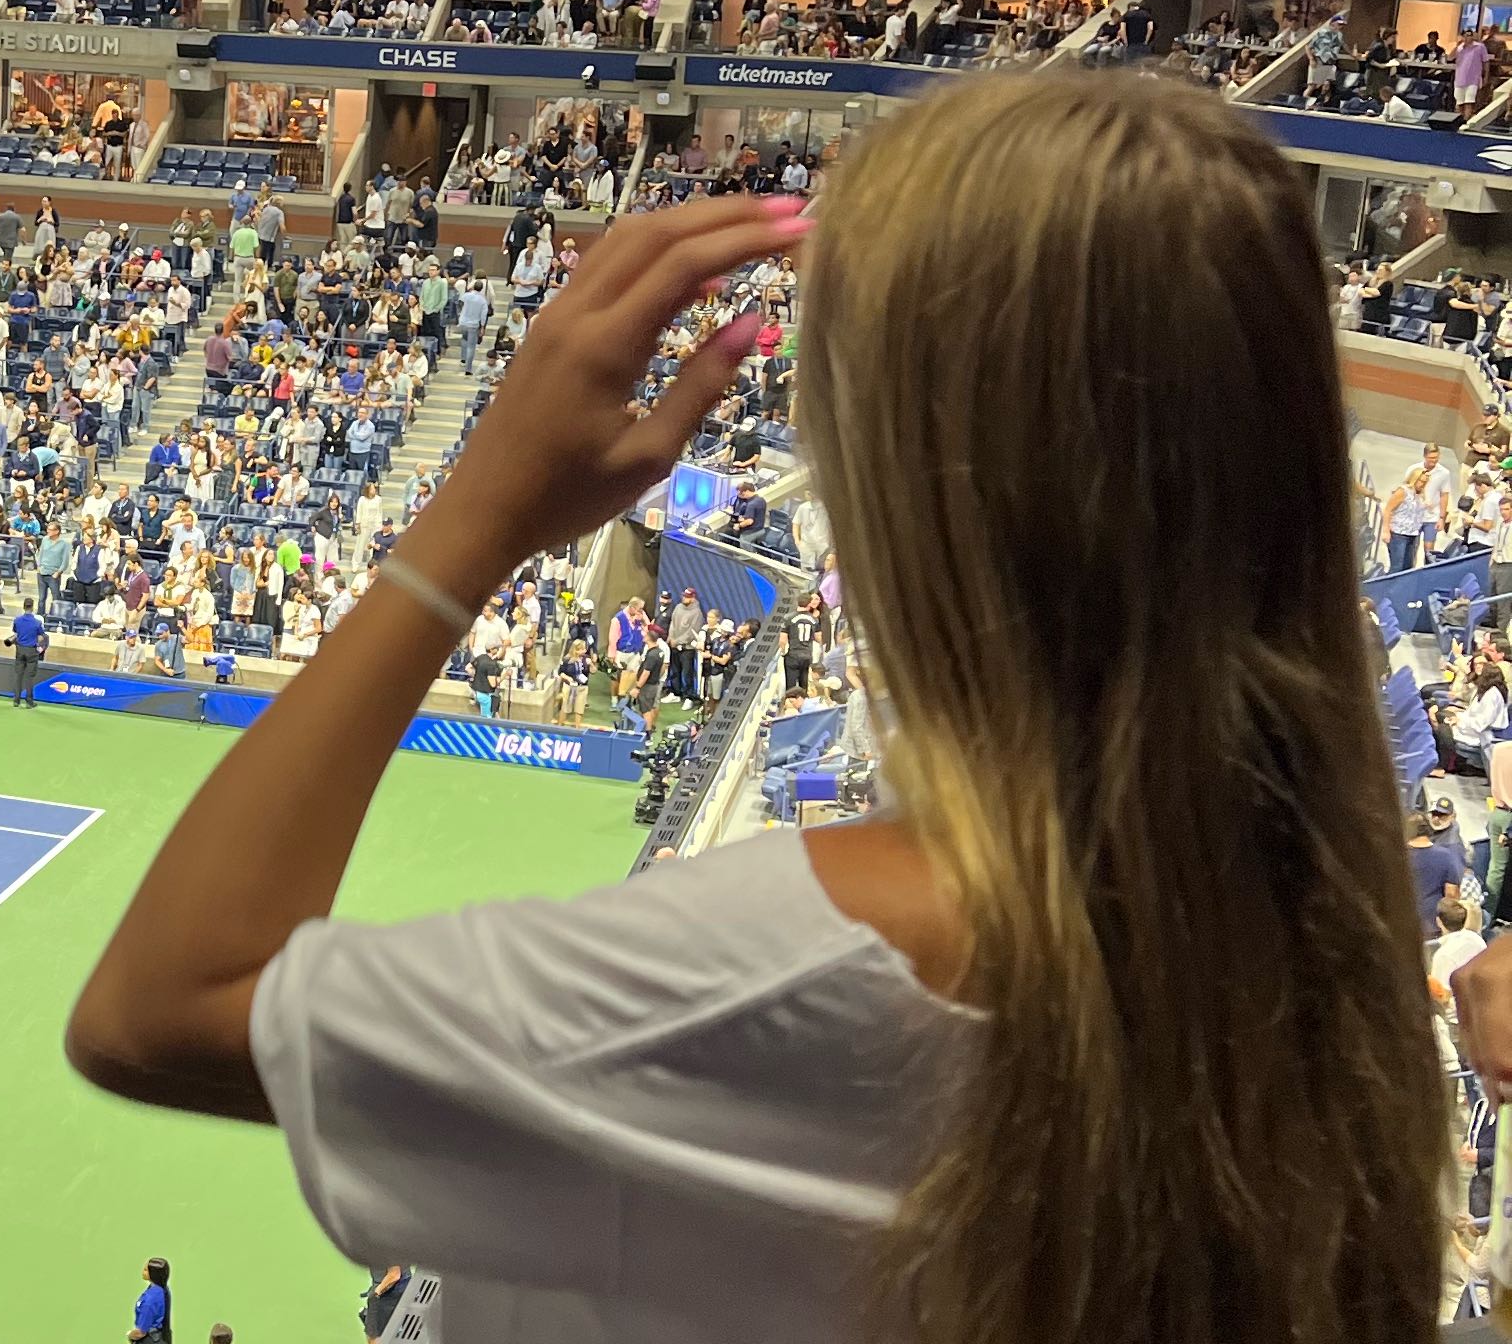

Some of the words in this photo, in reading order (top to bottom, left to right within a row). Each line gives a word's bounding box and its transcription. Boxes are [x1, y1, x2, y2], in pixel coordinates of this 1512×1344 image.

[24, 32, 120, 56] STADIUM
[379, 48, 458, 68] CHASE
[718, 63, 833, 87] ticketmaster
[797, 623, 811, 642] 11
[69, 684, 82, 694] us
[82, 686, 106, 696] open
[495, 733, 532, 756] IGA
